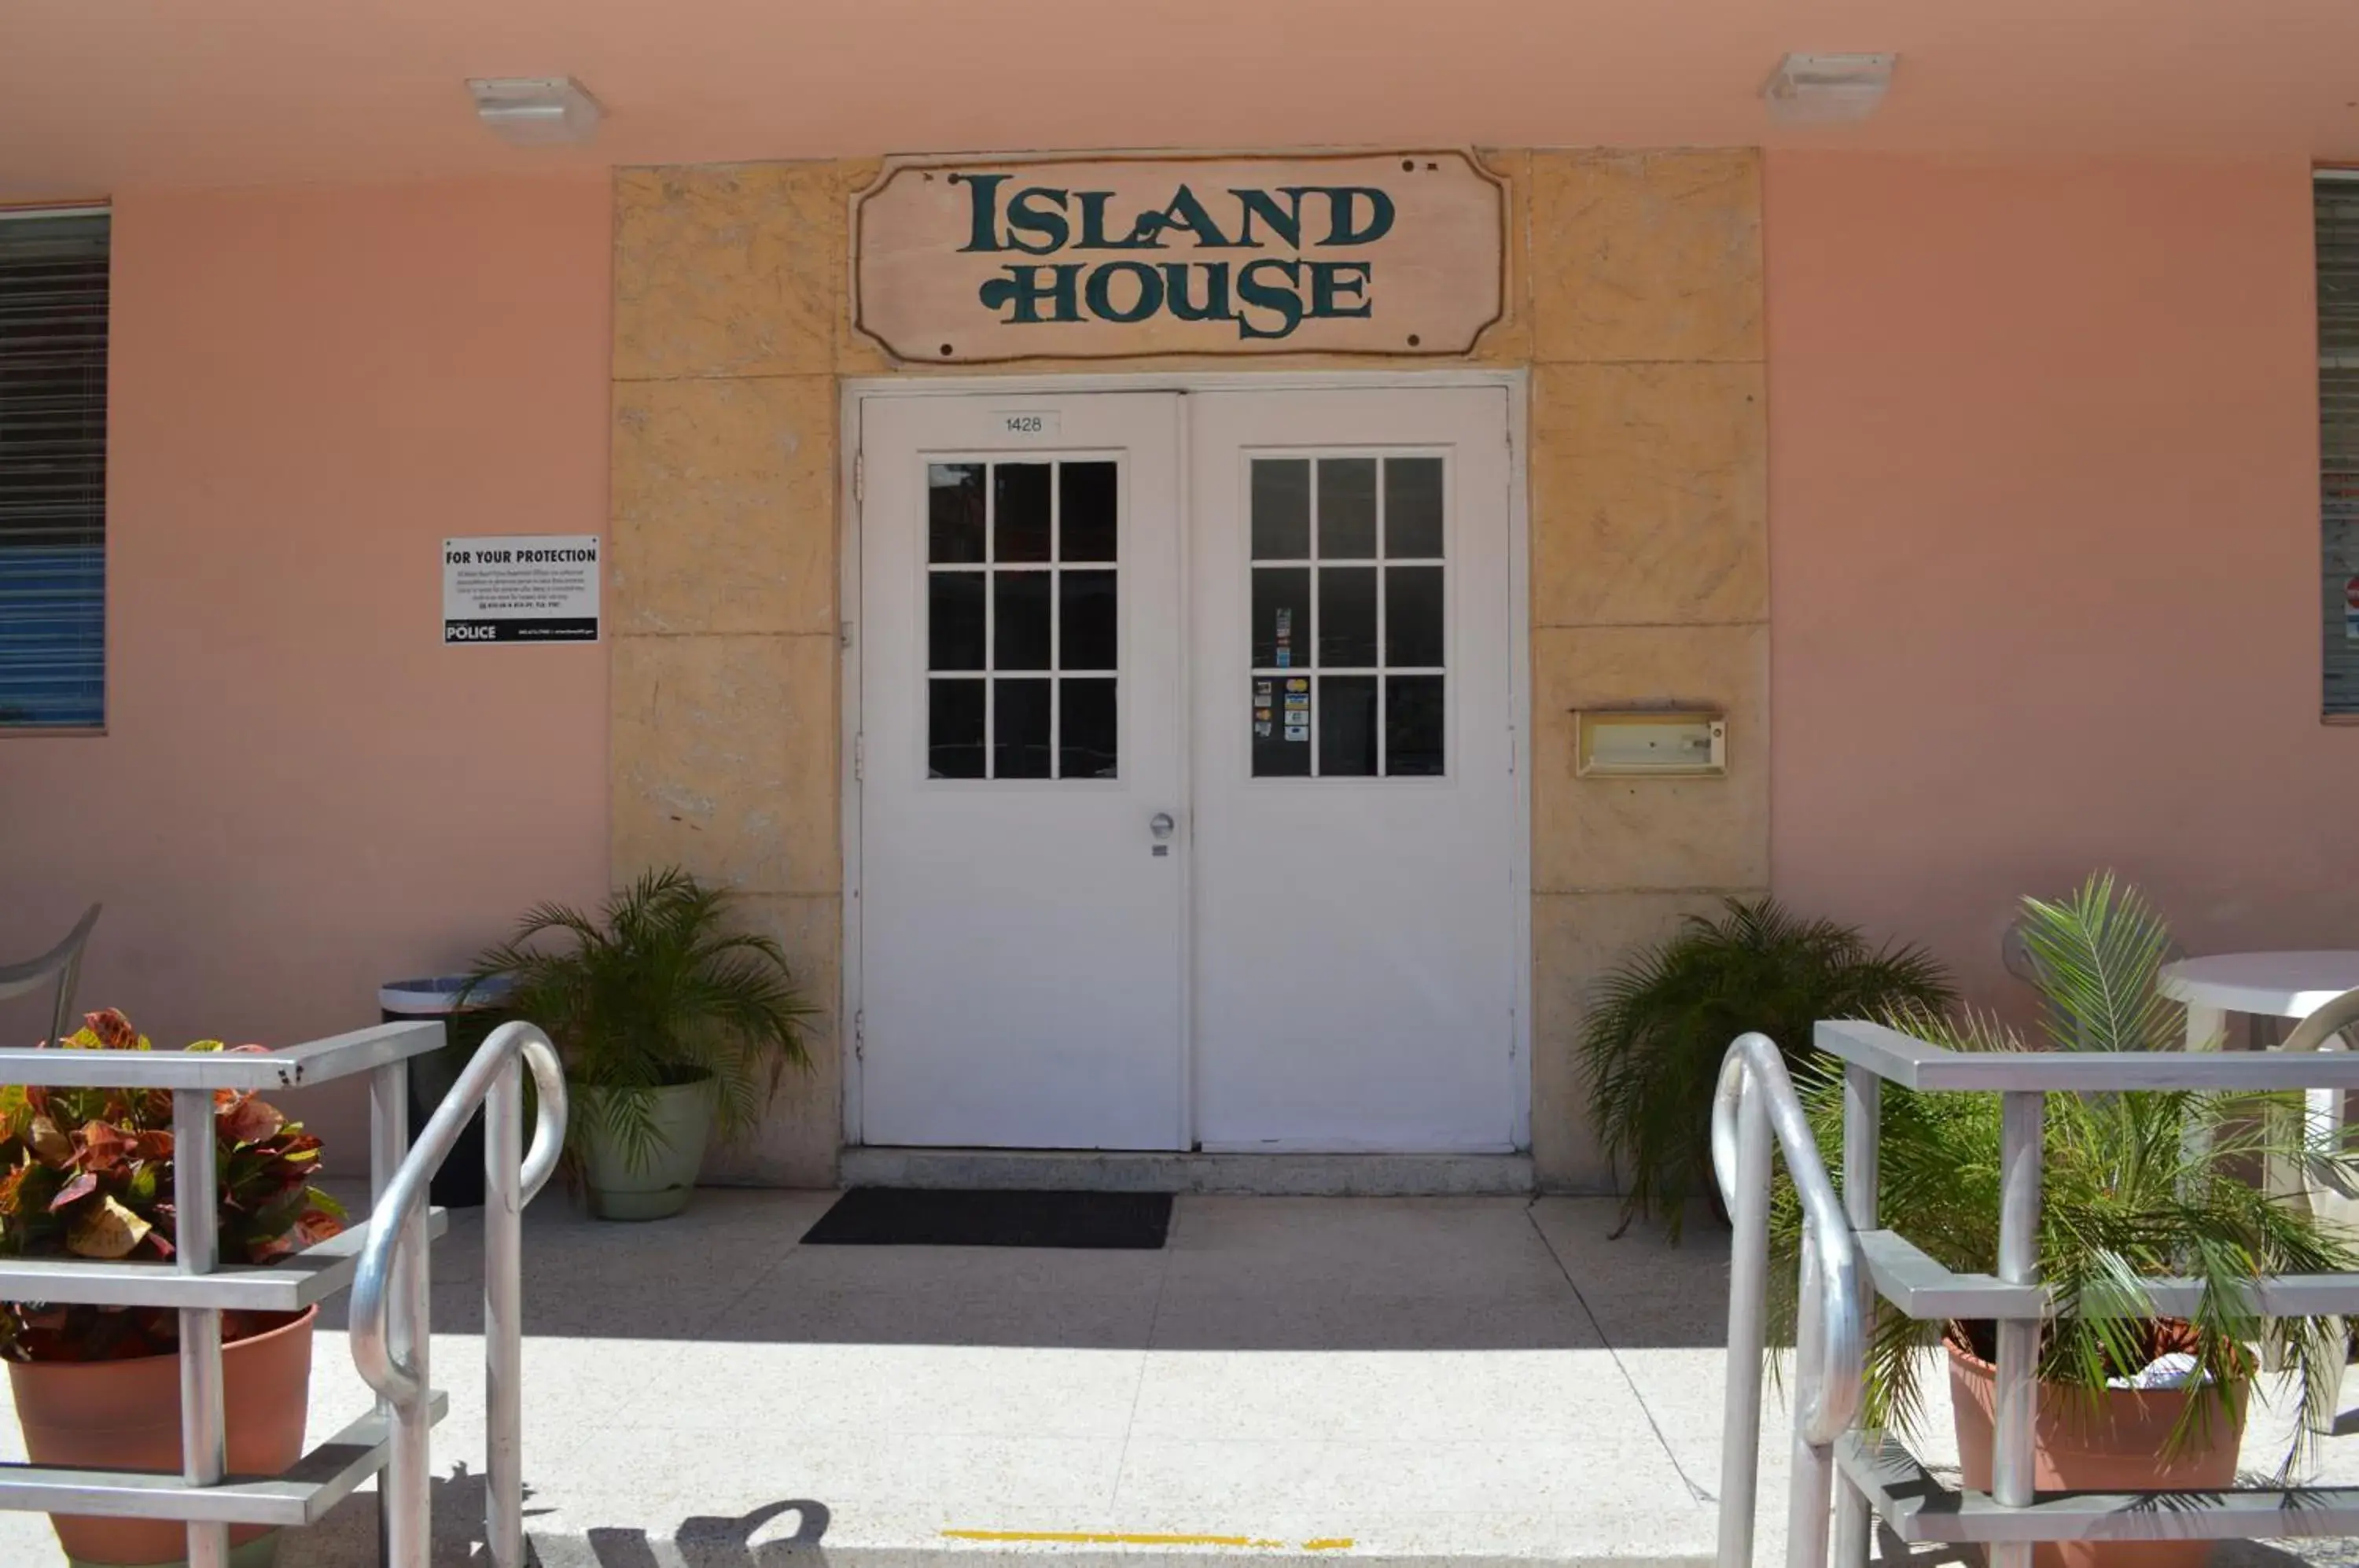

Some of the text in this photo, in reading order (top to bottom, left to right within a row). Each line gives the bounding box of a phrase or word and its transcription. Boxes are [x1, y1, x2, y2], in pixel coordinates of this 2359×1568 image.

[956, 174, 1395, 256] ISLAND
[978, 256, 1372, 341] HOUSE
[1007, 417, 1042, 432] 1428
[446, 549, 596, 564] FOR YOUR PROTECTION
[446, 626, 496, 639] POLICE
